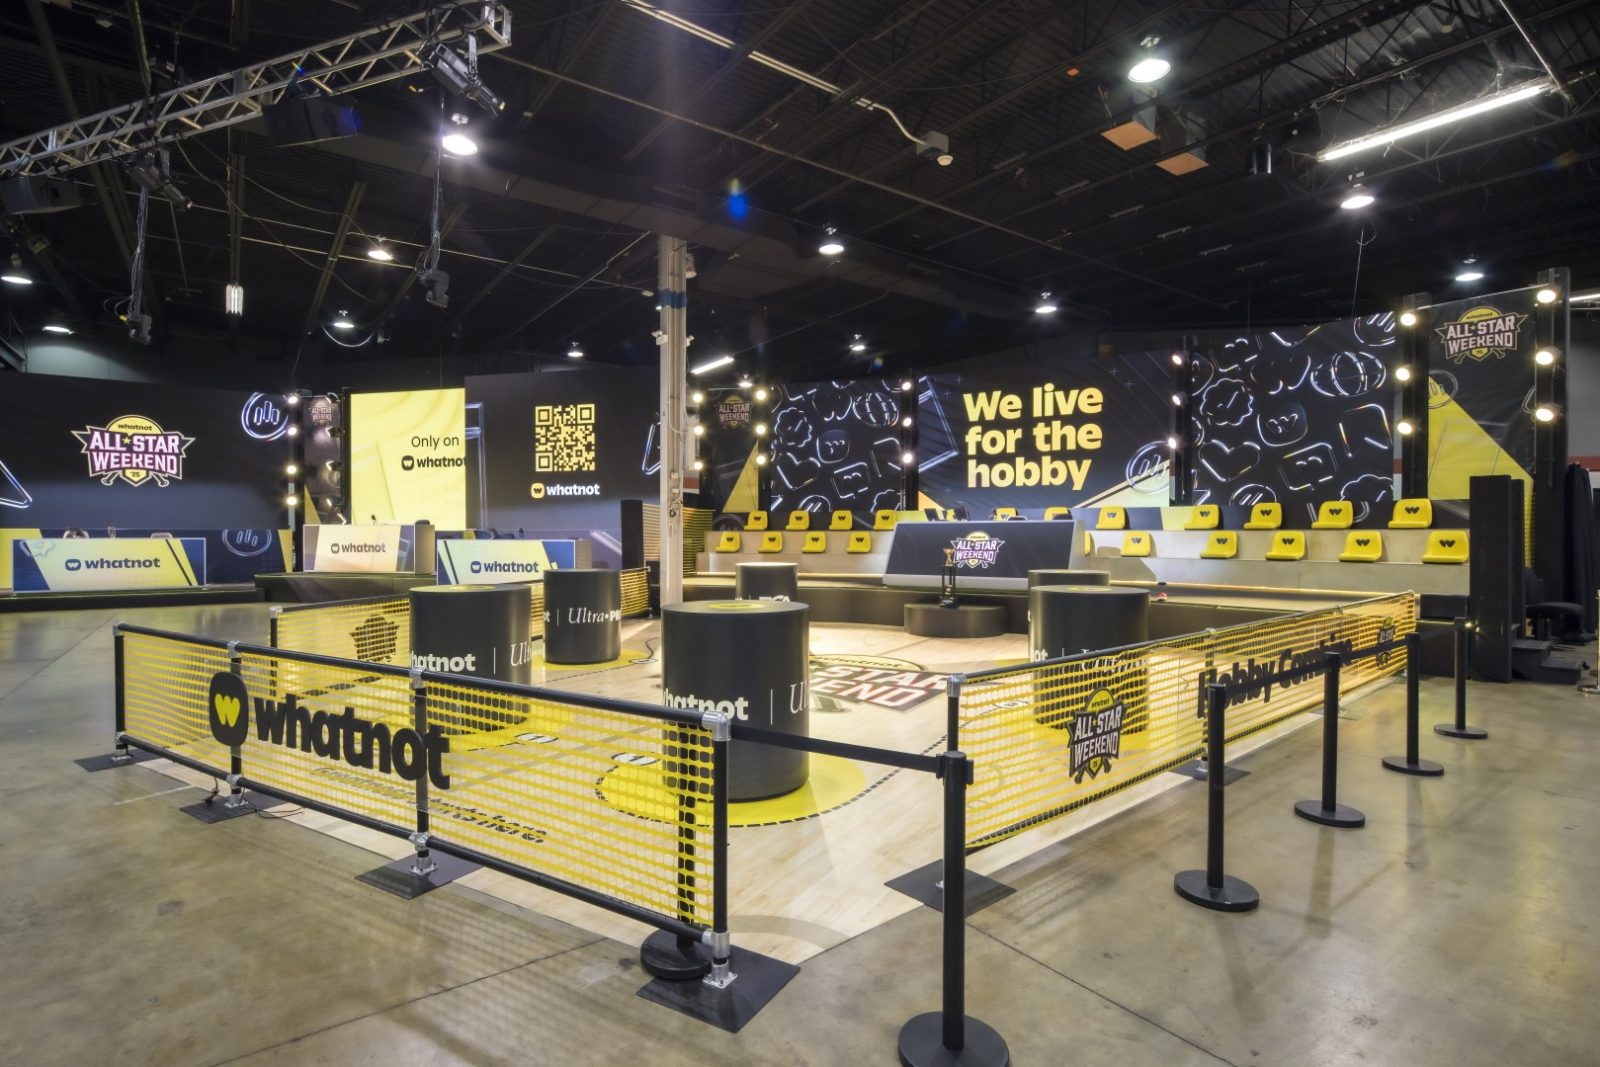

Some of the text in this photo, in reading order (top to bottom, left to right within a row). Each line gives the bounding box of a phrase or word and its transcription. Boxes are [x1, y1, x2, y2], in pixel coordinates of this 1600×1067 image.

[1446, 315, 1515, 340] ALL STAR
[1448, 332, 1513, 355] WEEKEND
[963, 382, 1104, 422] We live
[118, 423, 152, 431] whatnot
[965, 420, 1102, 455] for the
[89, 431, 180, 453] ALL STAR
[411, 435, 460, 451] Only on
[92, 451, 178, 475] WEEKEND
[967, 455, 1092, 490] hobby
[546, 483, 600, 496] whatnot
[341, 542, 386, 553] whatnot
[956, 540, 998, 550] ALL STAR
[956, 550, 995, 562] WEEKEND
[84, 558, 160, 569] whatnot
[483, 560, 539, 573] whatnot
[410, 650, 476, 672] hatnot
[1074, 705, 1122, 741] ALL STAR
[254, 693, 450, 790] whatnot
[1074, 731, 1119, 769] WEEKEND
